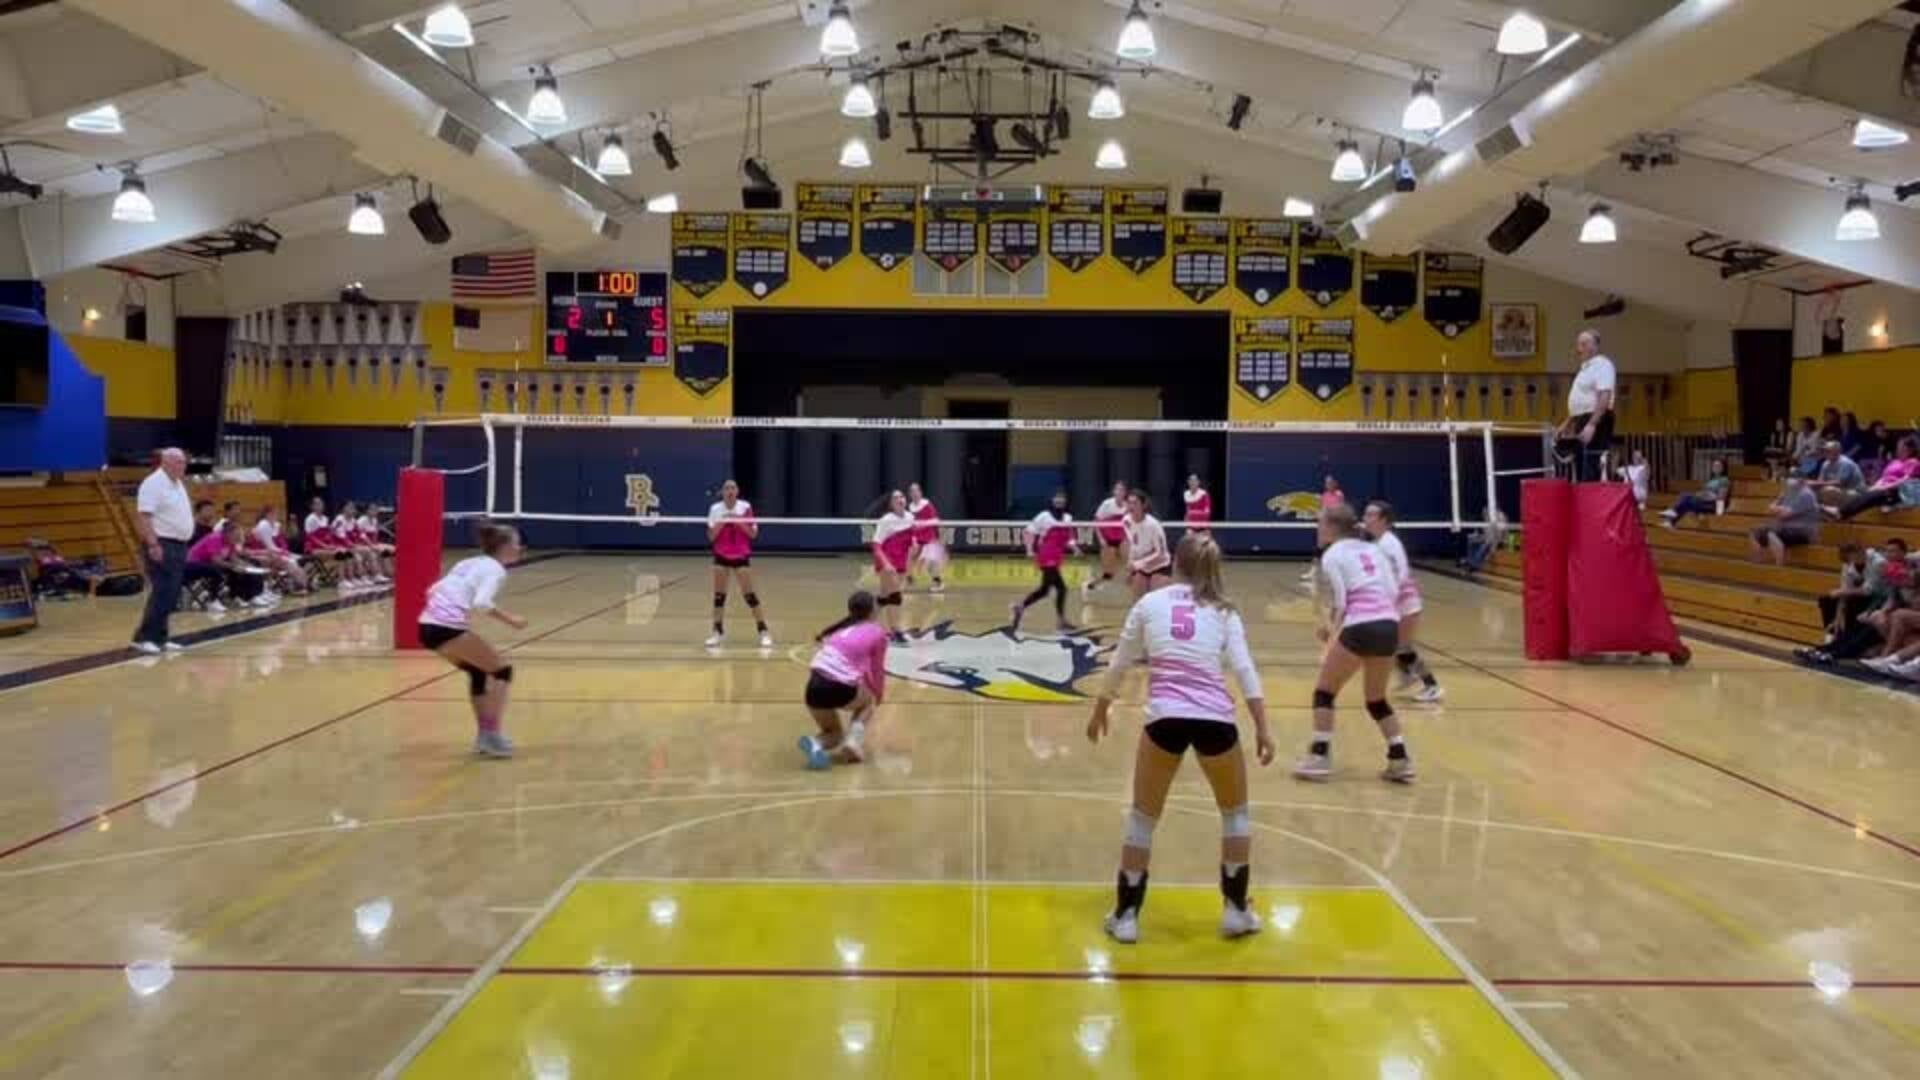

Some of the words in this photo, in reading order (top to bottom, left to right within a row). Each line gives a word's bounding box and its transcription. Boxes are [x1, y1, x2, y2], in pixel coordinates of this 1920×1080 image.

[599, 273, 635, 294] 1:00
[633, 297, 663, 306] GUEST
[567, 307, 582, 330] 2
[651, 308, 664, 330] 5
[1170, 605, 1196, 641] 5
